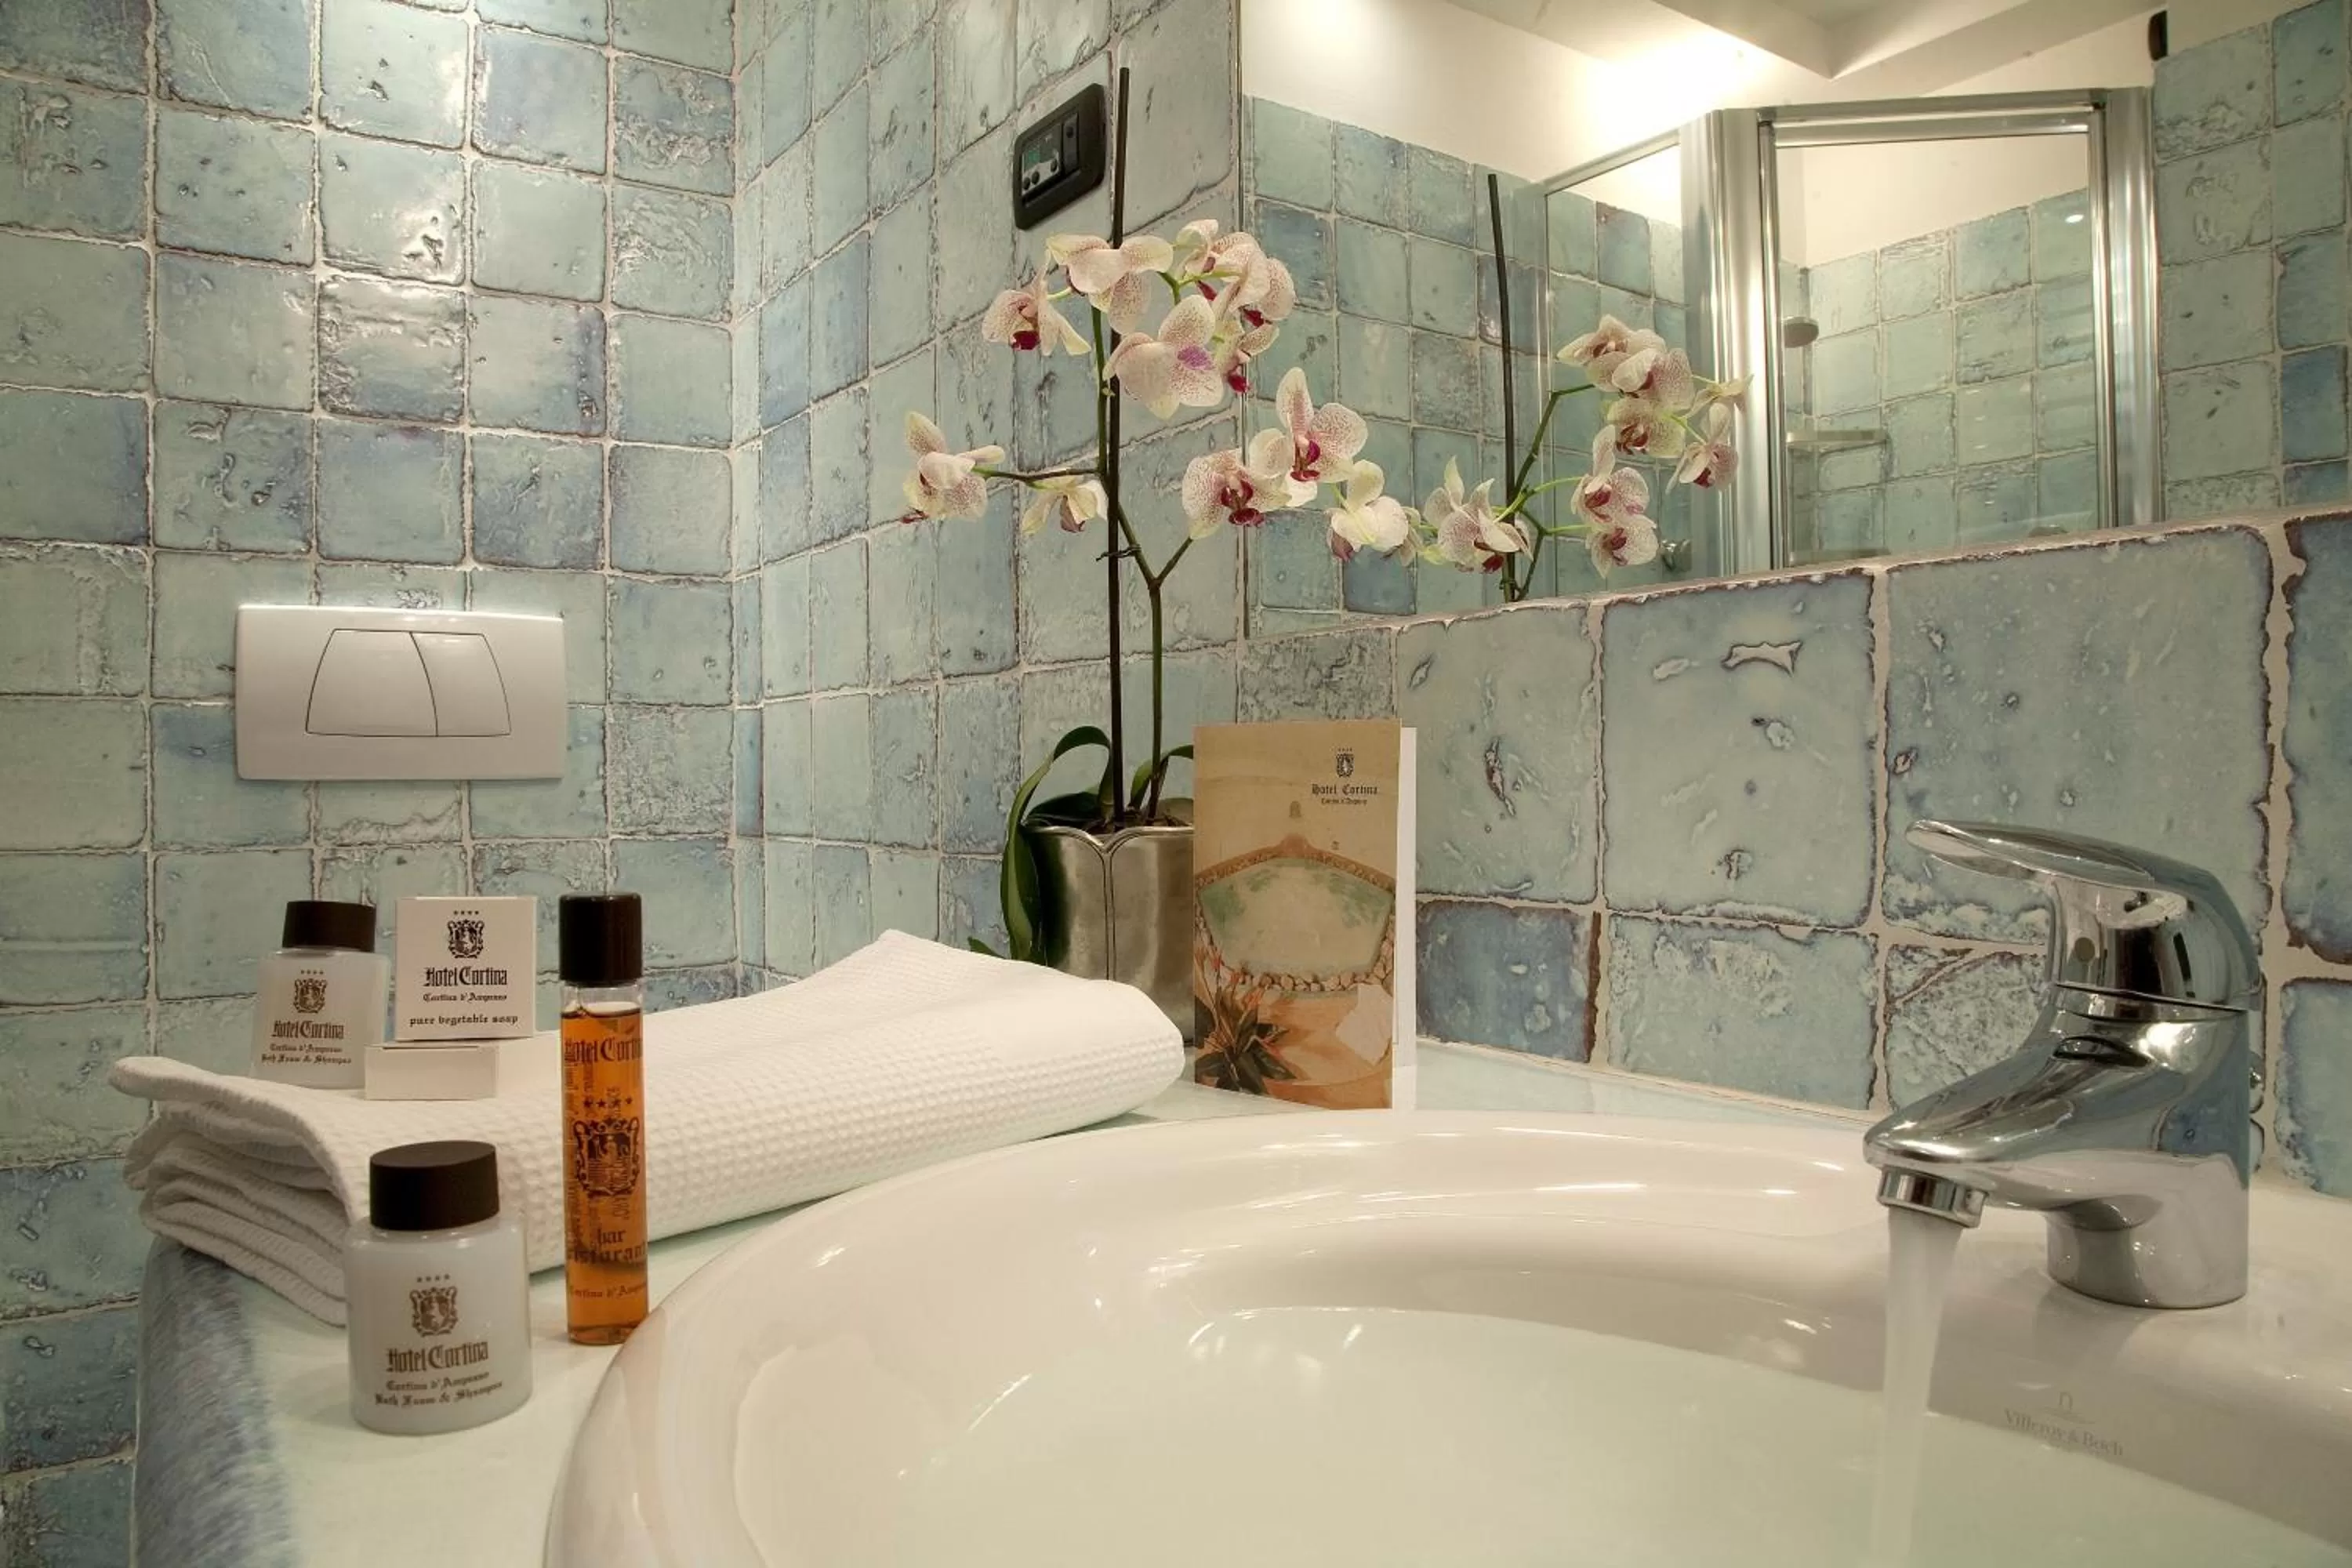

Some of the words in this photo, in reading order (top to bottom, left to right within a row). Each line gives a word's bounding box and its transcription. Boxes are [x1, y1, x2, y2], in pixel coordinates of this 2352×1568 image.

[1312, 783, 1337, 795] Hotel
[1341, 783, 1378, 795] Cortina
[423, 967, 457, 987] Hotel
[459, 966, 508, 985] Cortina
[270, 1020, 299, 1038] Hotel
[299, 1020, 344, 1040] Cortina
[409, 1017, 435, 1027] pure
[437, 1013, 488, 1026] vegetable
[492, 1015, 518, 1025] soap
[387, 1348, 427, 1373] Hotel
[428, 1341, 489, 1370] Cortina
